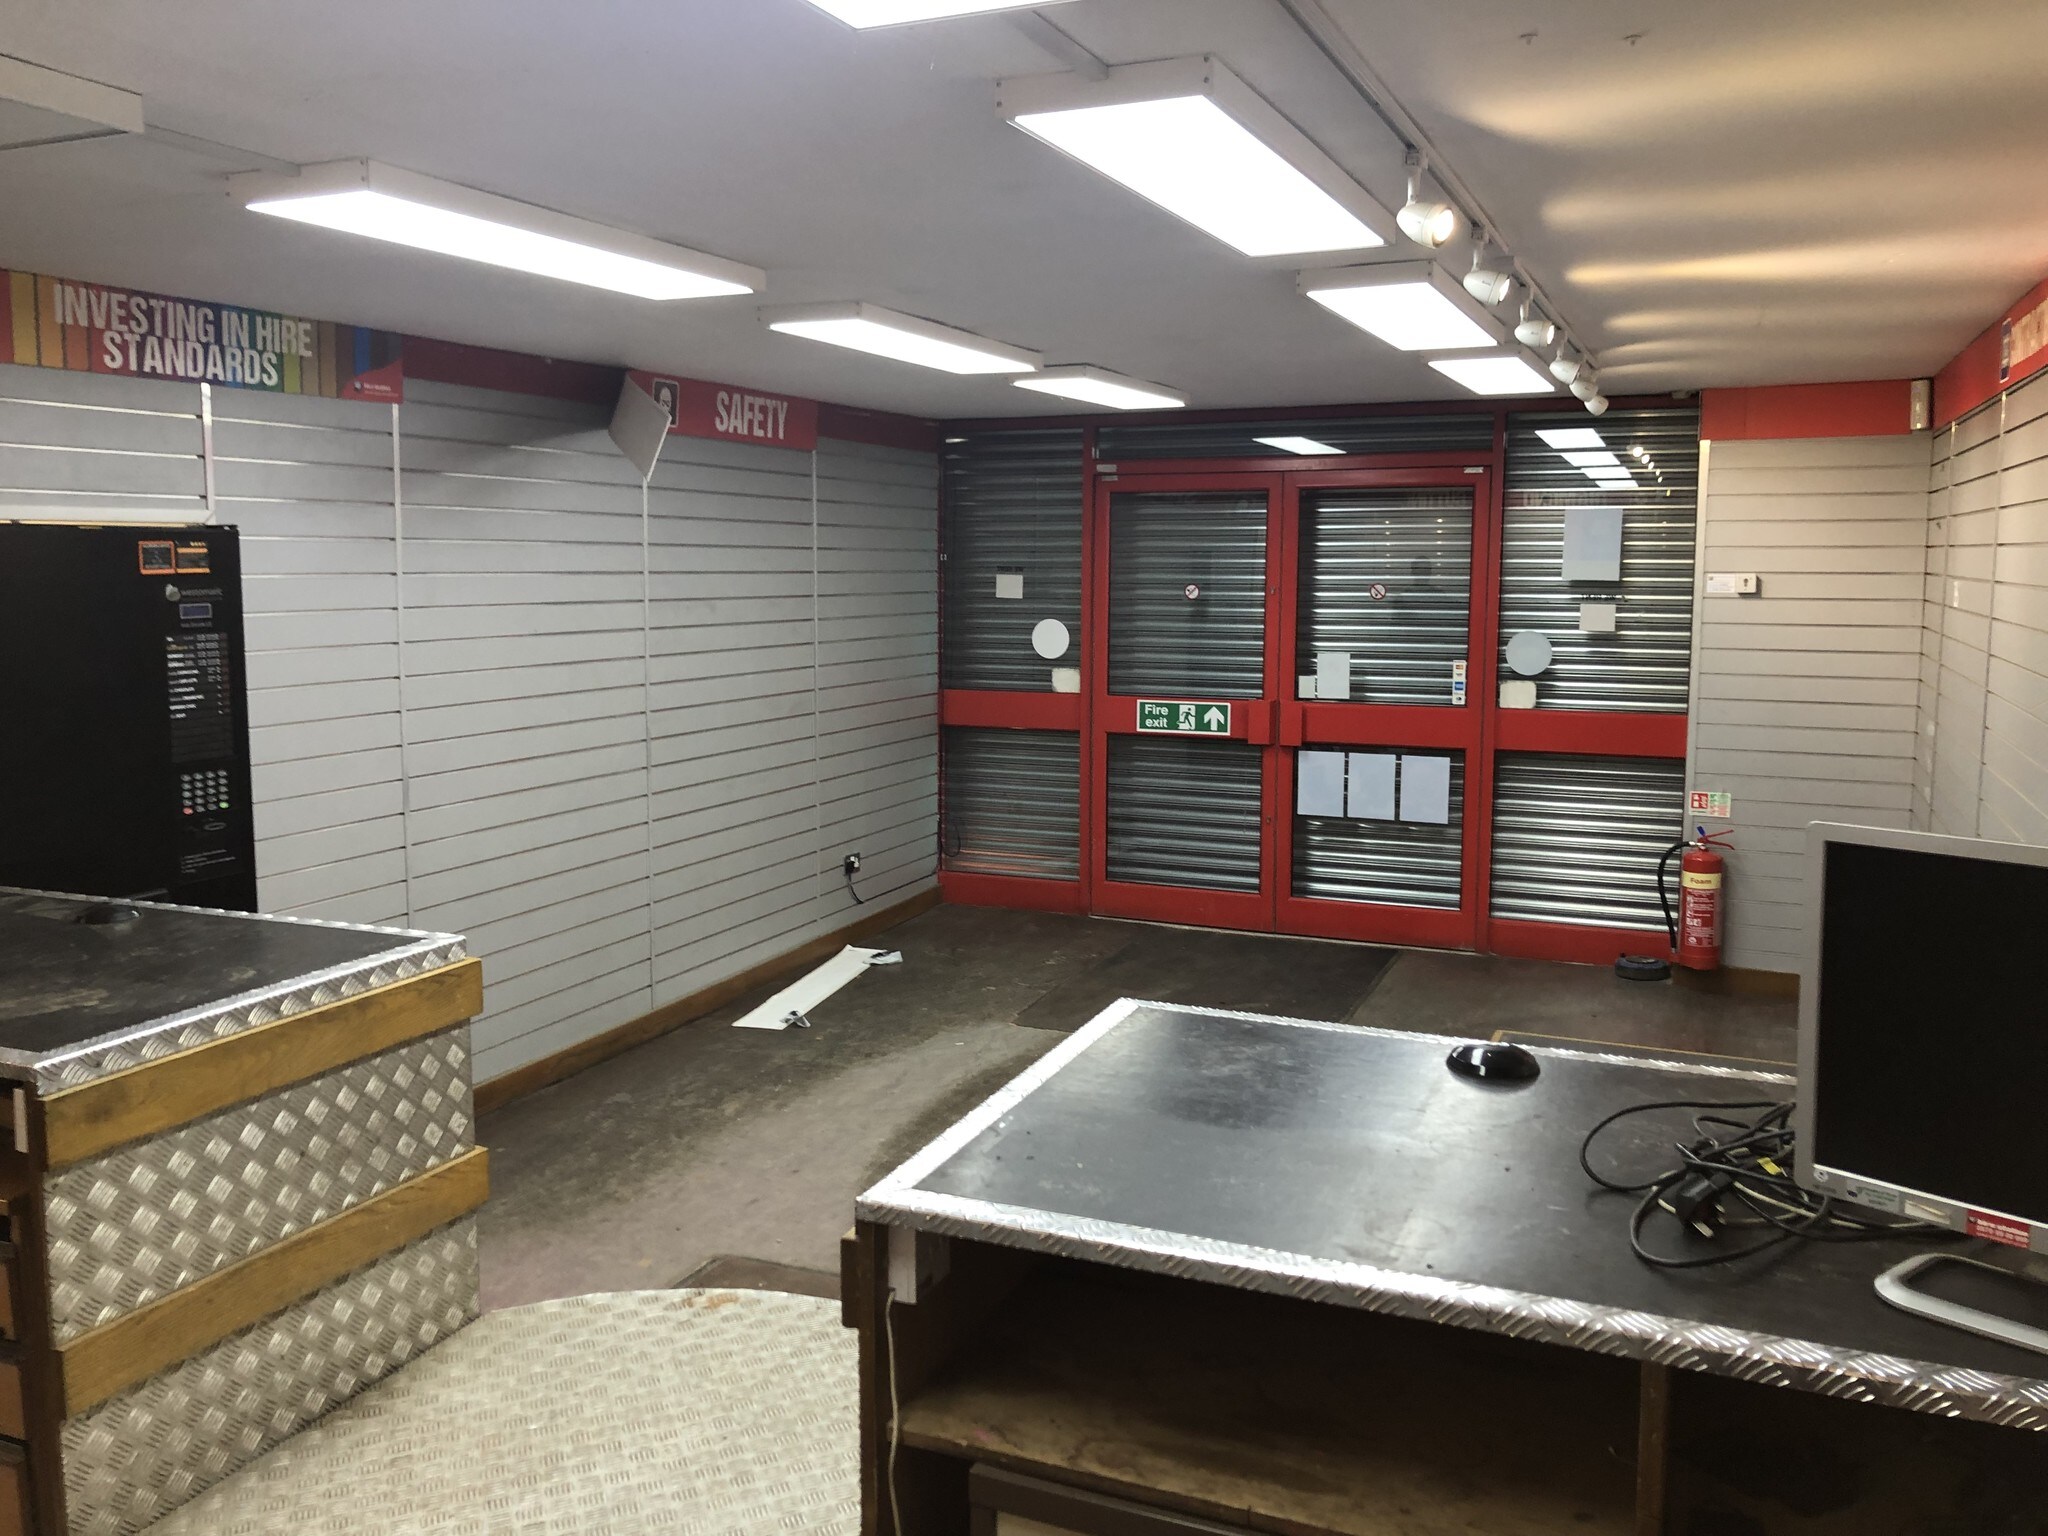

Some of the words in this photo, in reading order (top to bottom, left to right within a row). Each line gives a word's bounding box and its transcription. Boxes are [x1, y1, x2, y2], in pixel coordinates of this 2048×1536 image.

[54, 284, 214, 341] INVESTING
[221, 310, 249, 348] IN
[255, 316, 312, 358] HIRE
[102, 331, 279, 387] STANDARDS
[715, 391, 788, 439] SAFETY
[1144, 704, 1168, 715] Fire
[1145, 717, 1168, 728] exit
[1690, 877, 1712, 885] Foam
